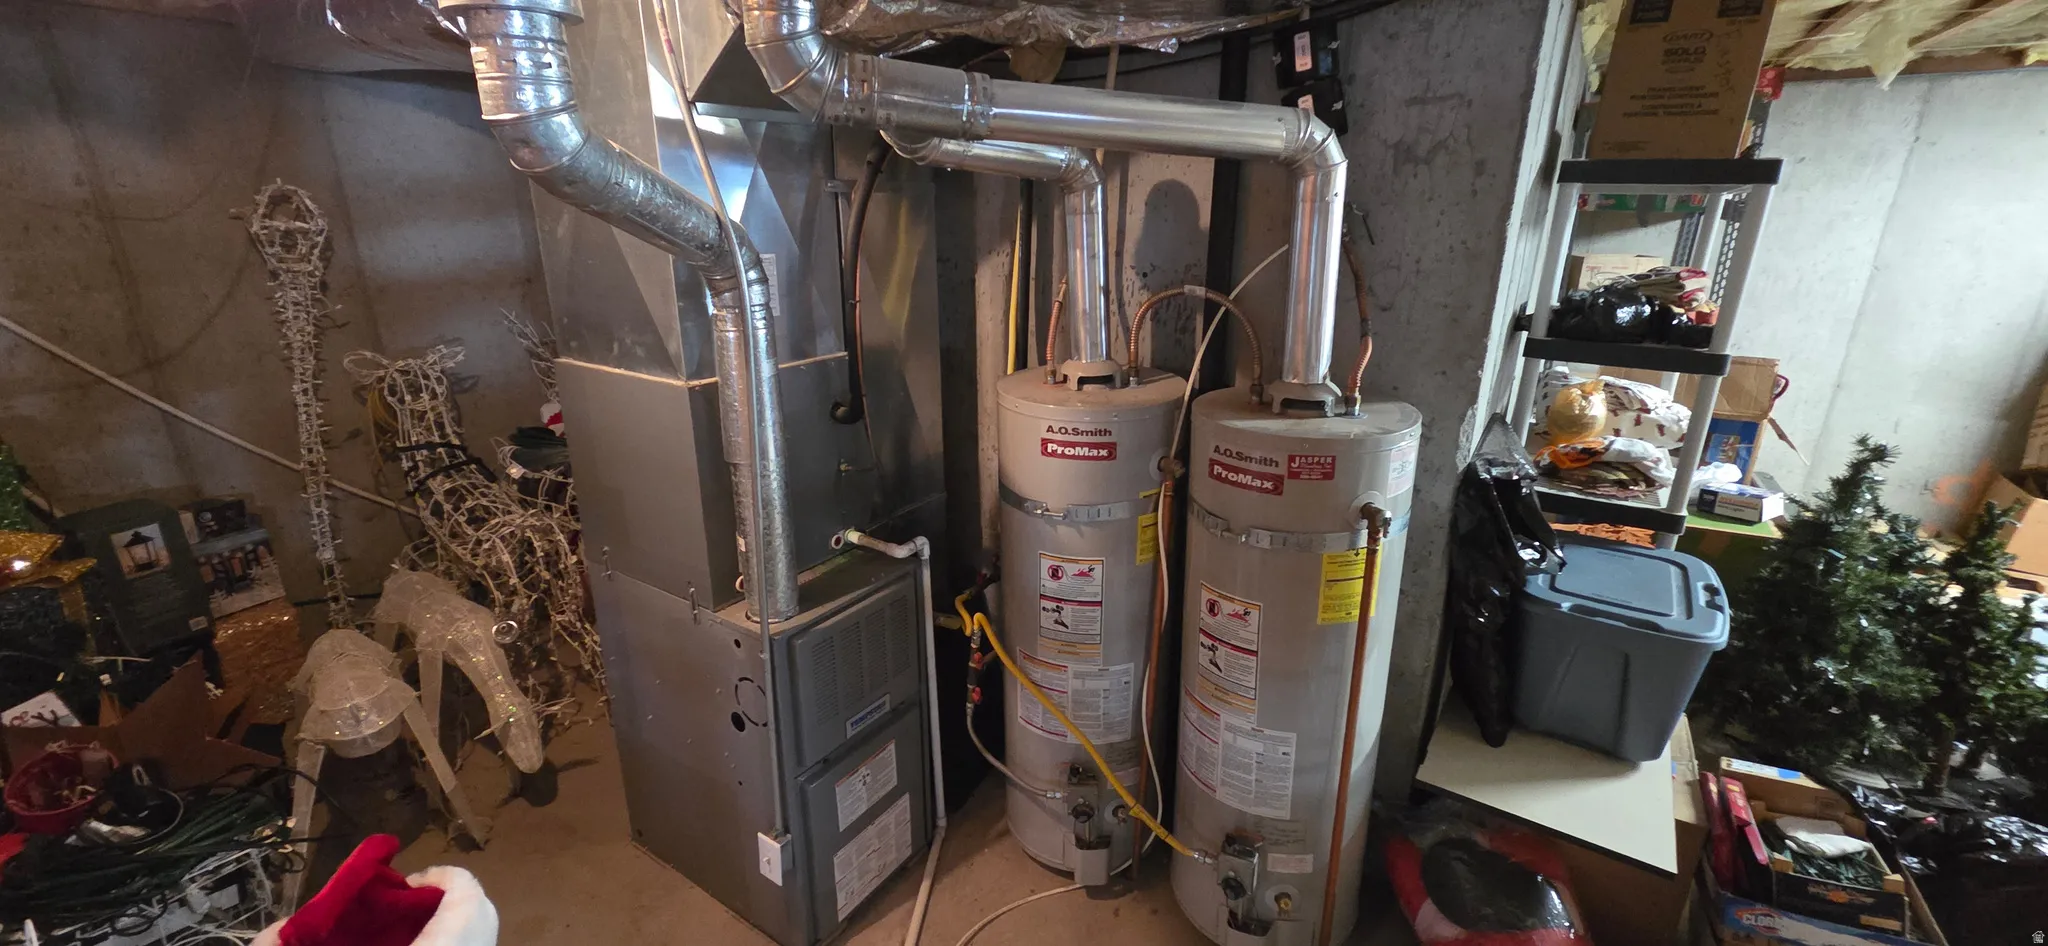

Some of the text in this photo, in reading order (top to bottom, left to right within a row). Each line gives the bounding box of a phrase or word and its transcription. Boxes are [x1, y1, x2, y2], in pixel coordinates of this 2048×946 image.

[1046, 425, 1112, 437] A.O.Smith
[1047, 443, 1109, 456] ProMax
[1213, 444, 1279, 468] A.O.Smith
[1291, 456, 1332, 468] JASPER
[1213, 464, 1275, 490] ProMax
